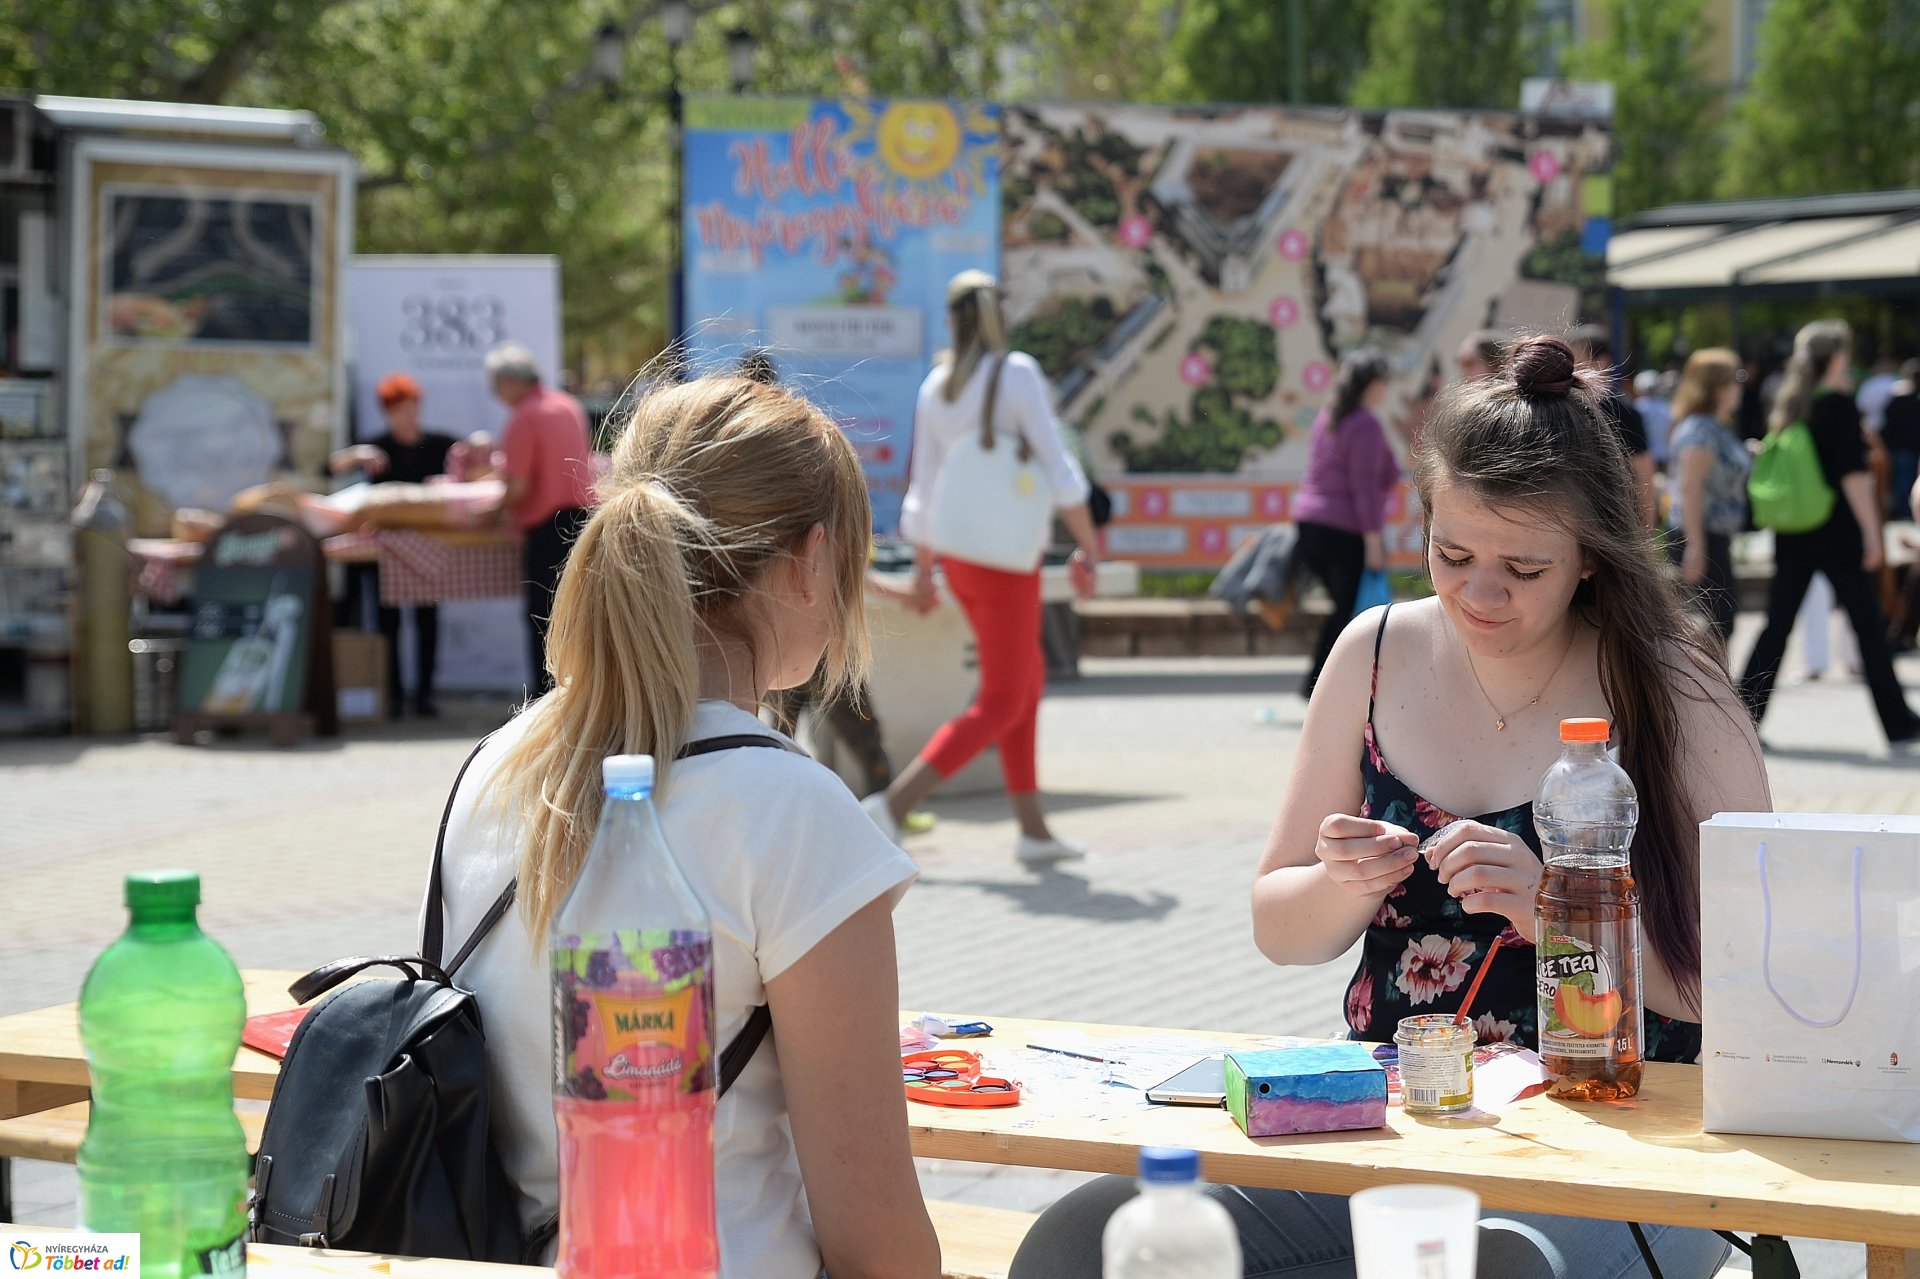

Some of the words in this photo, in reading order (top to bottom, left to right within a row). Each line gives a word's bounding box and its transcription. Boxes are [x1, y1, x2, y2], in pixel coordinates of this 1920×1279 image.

[1558, 955, 1595, 974] TEA
[1538, 980, 1556, 997] ERO
[613, 1008, 674, 1035] MÁRKA
[1616, 1038, 1627, 1052] 1,5
